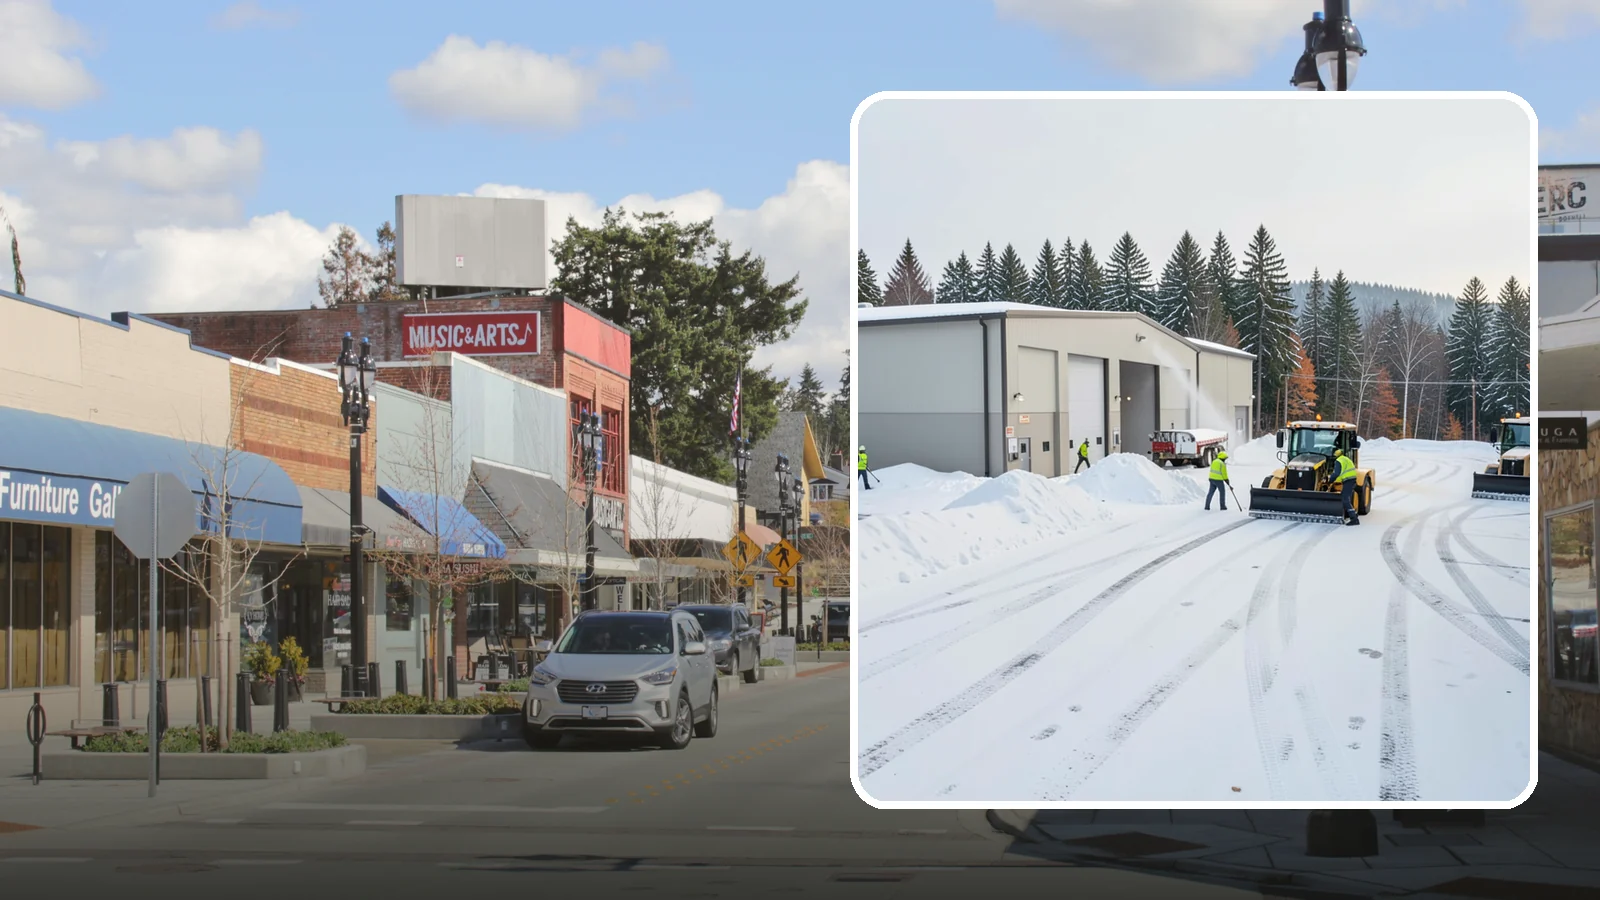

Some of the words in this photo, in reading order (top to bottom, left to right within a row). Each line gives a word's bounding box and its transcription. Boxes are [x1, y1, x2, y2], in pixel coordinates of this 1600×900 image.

[409, 323, 519, 349] MUSIC&ARTS
[0, 471, 79, 515] Furniture
[89, 482, 122, 519] Gal
